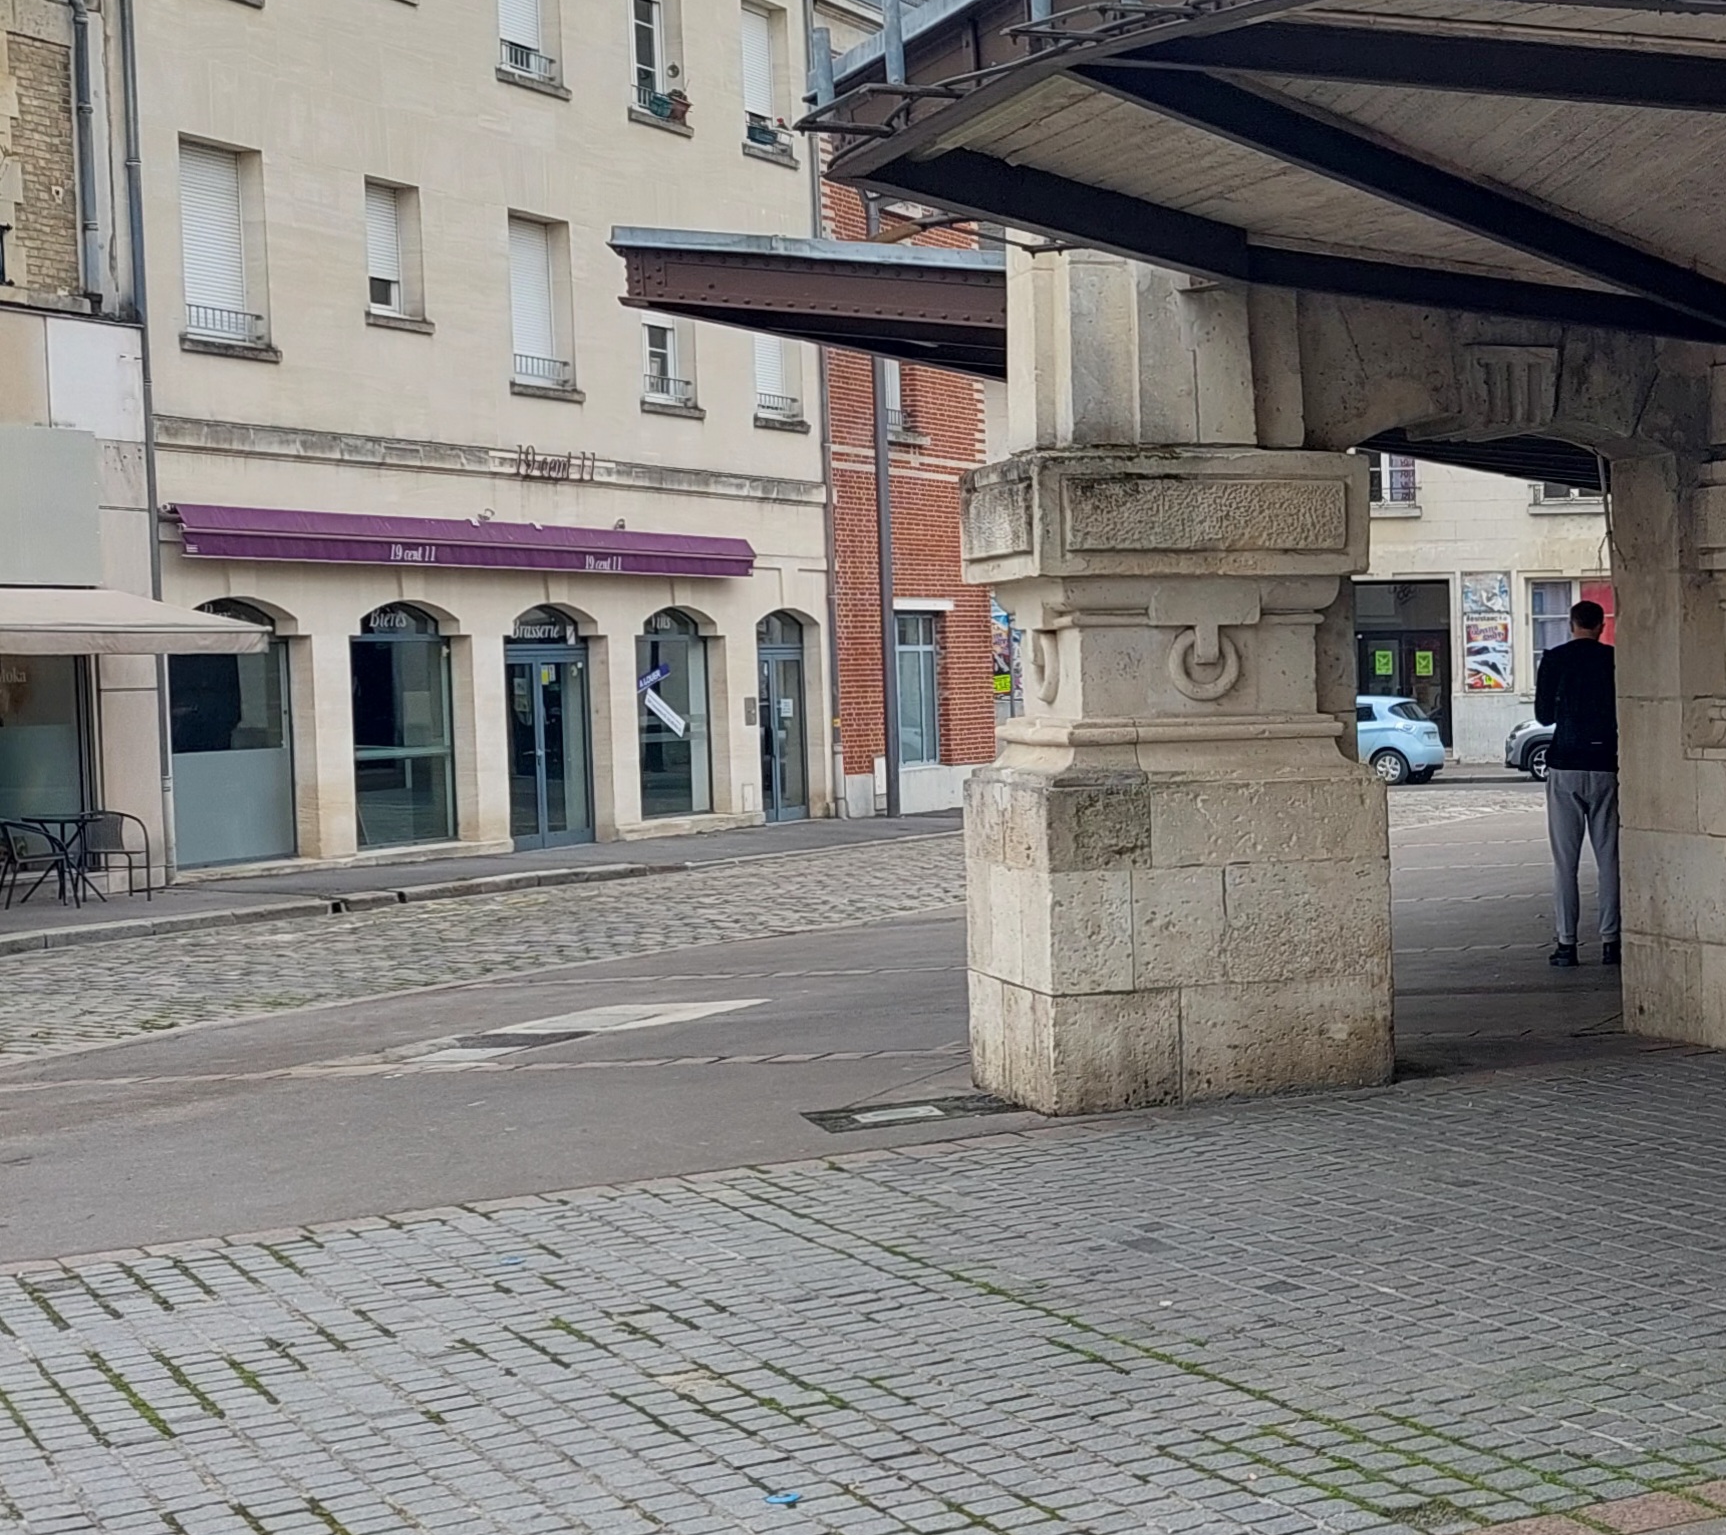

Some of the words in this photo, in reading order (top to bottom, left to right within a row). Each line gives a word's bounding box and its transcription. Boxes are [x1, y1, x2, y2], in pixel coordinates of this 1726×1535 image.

[516, 445, 535, 475] 19
[542, 451, 571, 479] cent
[581, 451, 595, 481] 11
[390, 544, 403, 560] 19
[404, 546, 422, 561] cent
[425, 546, 436, 561] 11
